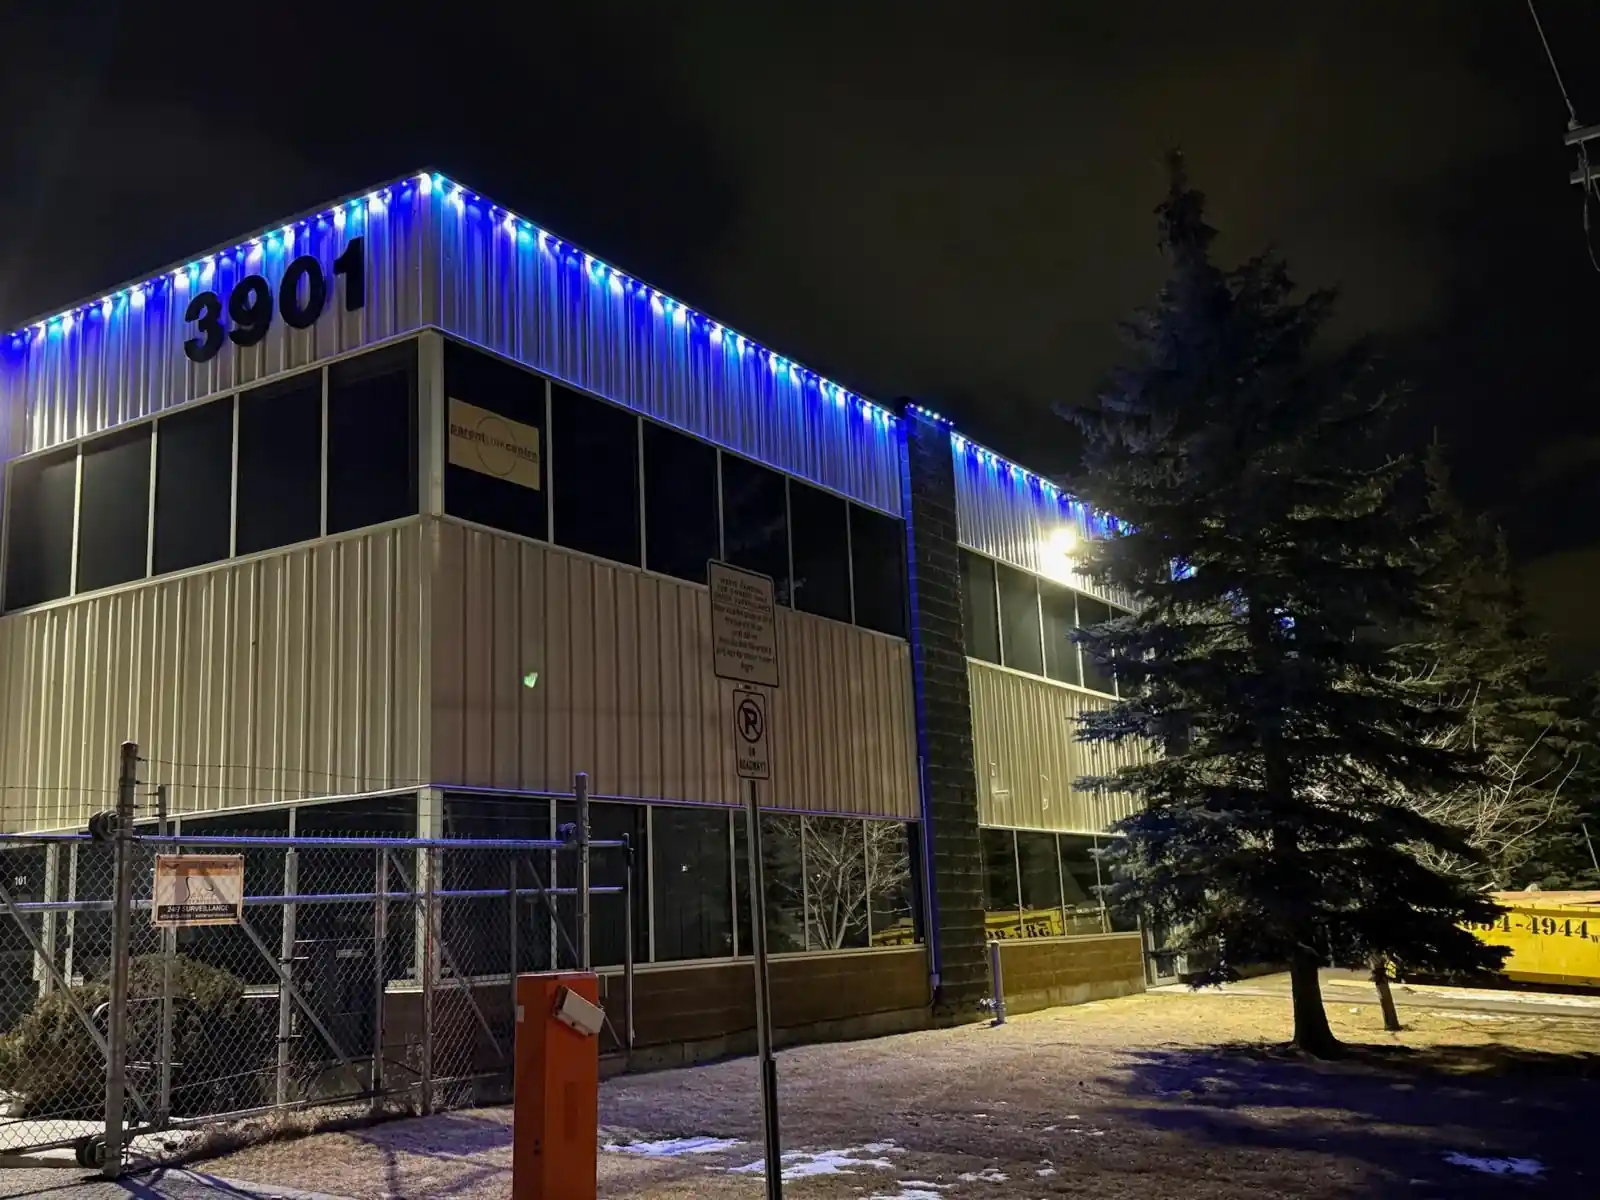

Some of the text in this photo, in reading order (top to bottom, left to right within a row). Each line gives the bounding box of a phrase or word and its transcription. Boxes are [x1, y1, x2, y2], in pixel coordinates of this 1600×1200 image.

[184, 236, 365, 363] 3901
[14, 875, 27, 886] 101
[182, 904, 230, 913] SURVEILLANCE
